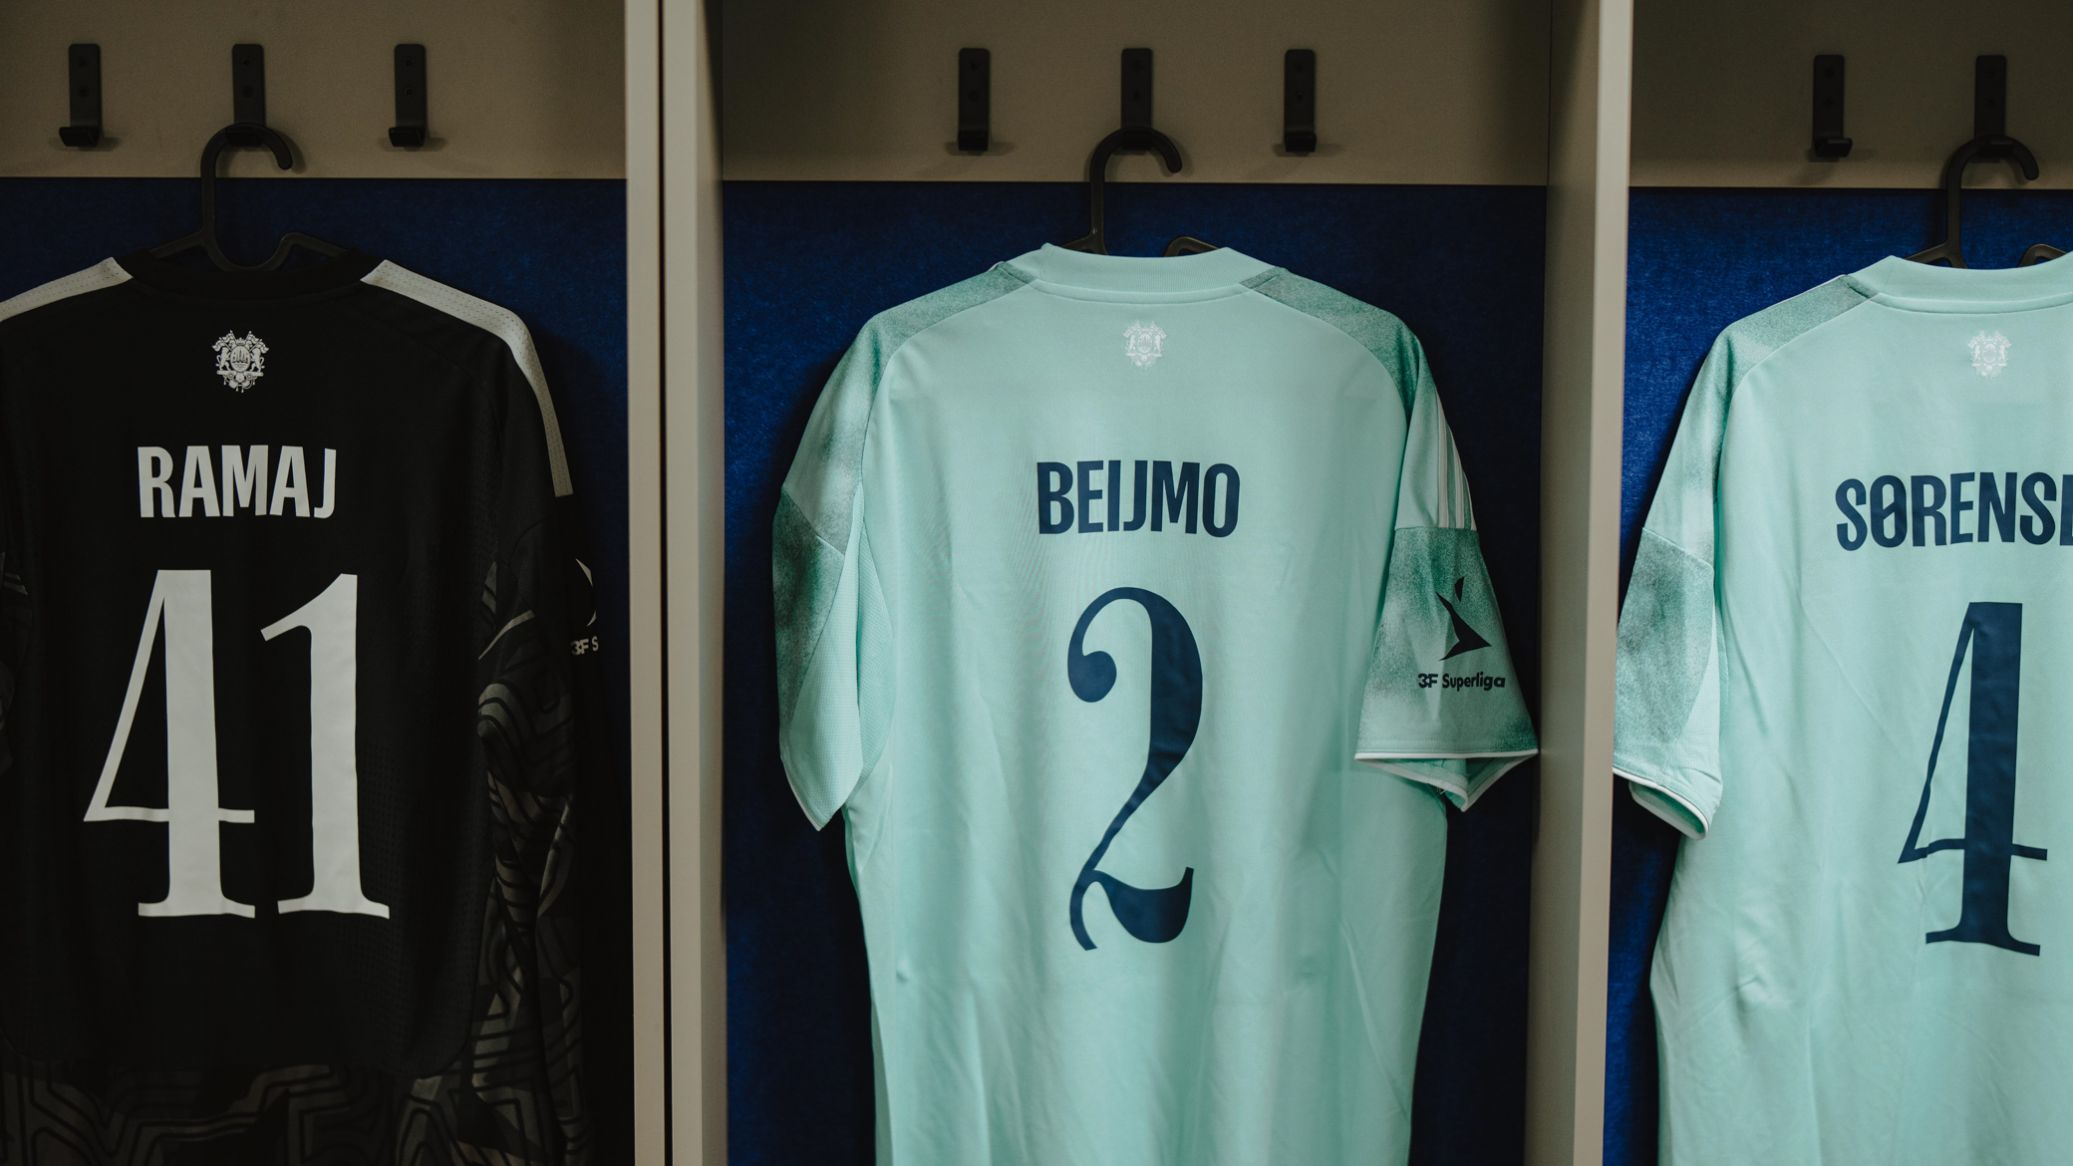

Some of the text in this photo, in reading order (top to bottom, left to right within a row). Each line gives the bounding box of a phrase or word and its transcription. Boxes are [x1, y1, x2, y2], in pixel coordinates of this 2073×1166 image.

[136, 444, 337, 519] RAMAJ
[1036, 459, 1241, 538] BEIJMO
[83, 568, 390, 920] 41
[1067, 586, 1204, 951] 2
[1417, 671, 1506, 692] 3F Superliga
[1897, 601, 2048, 957] 4
